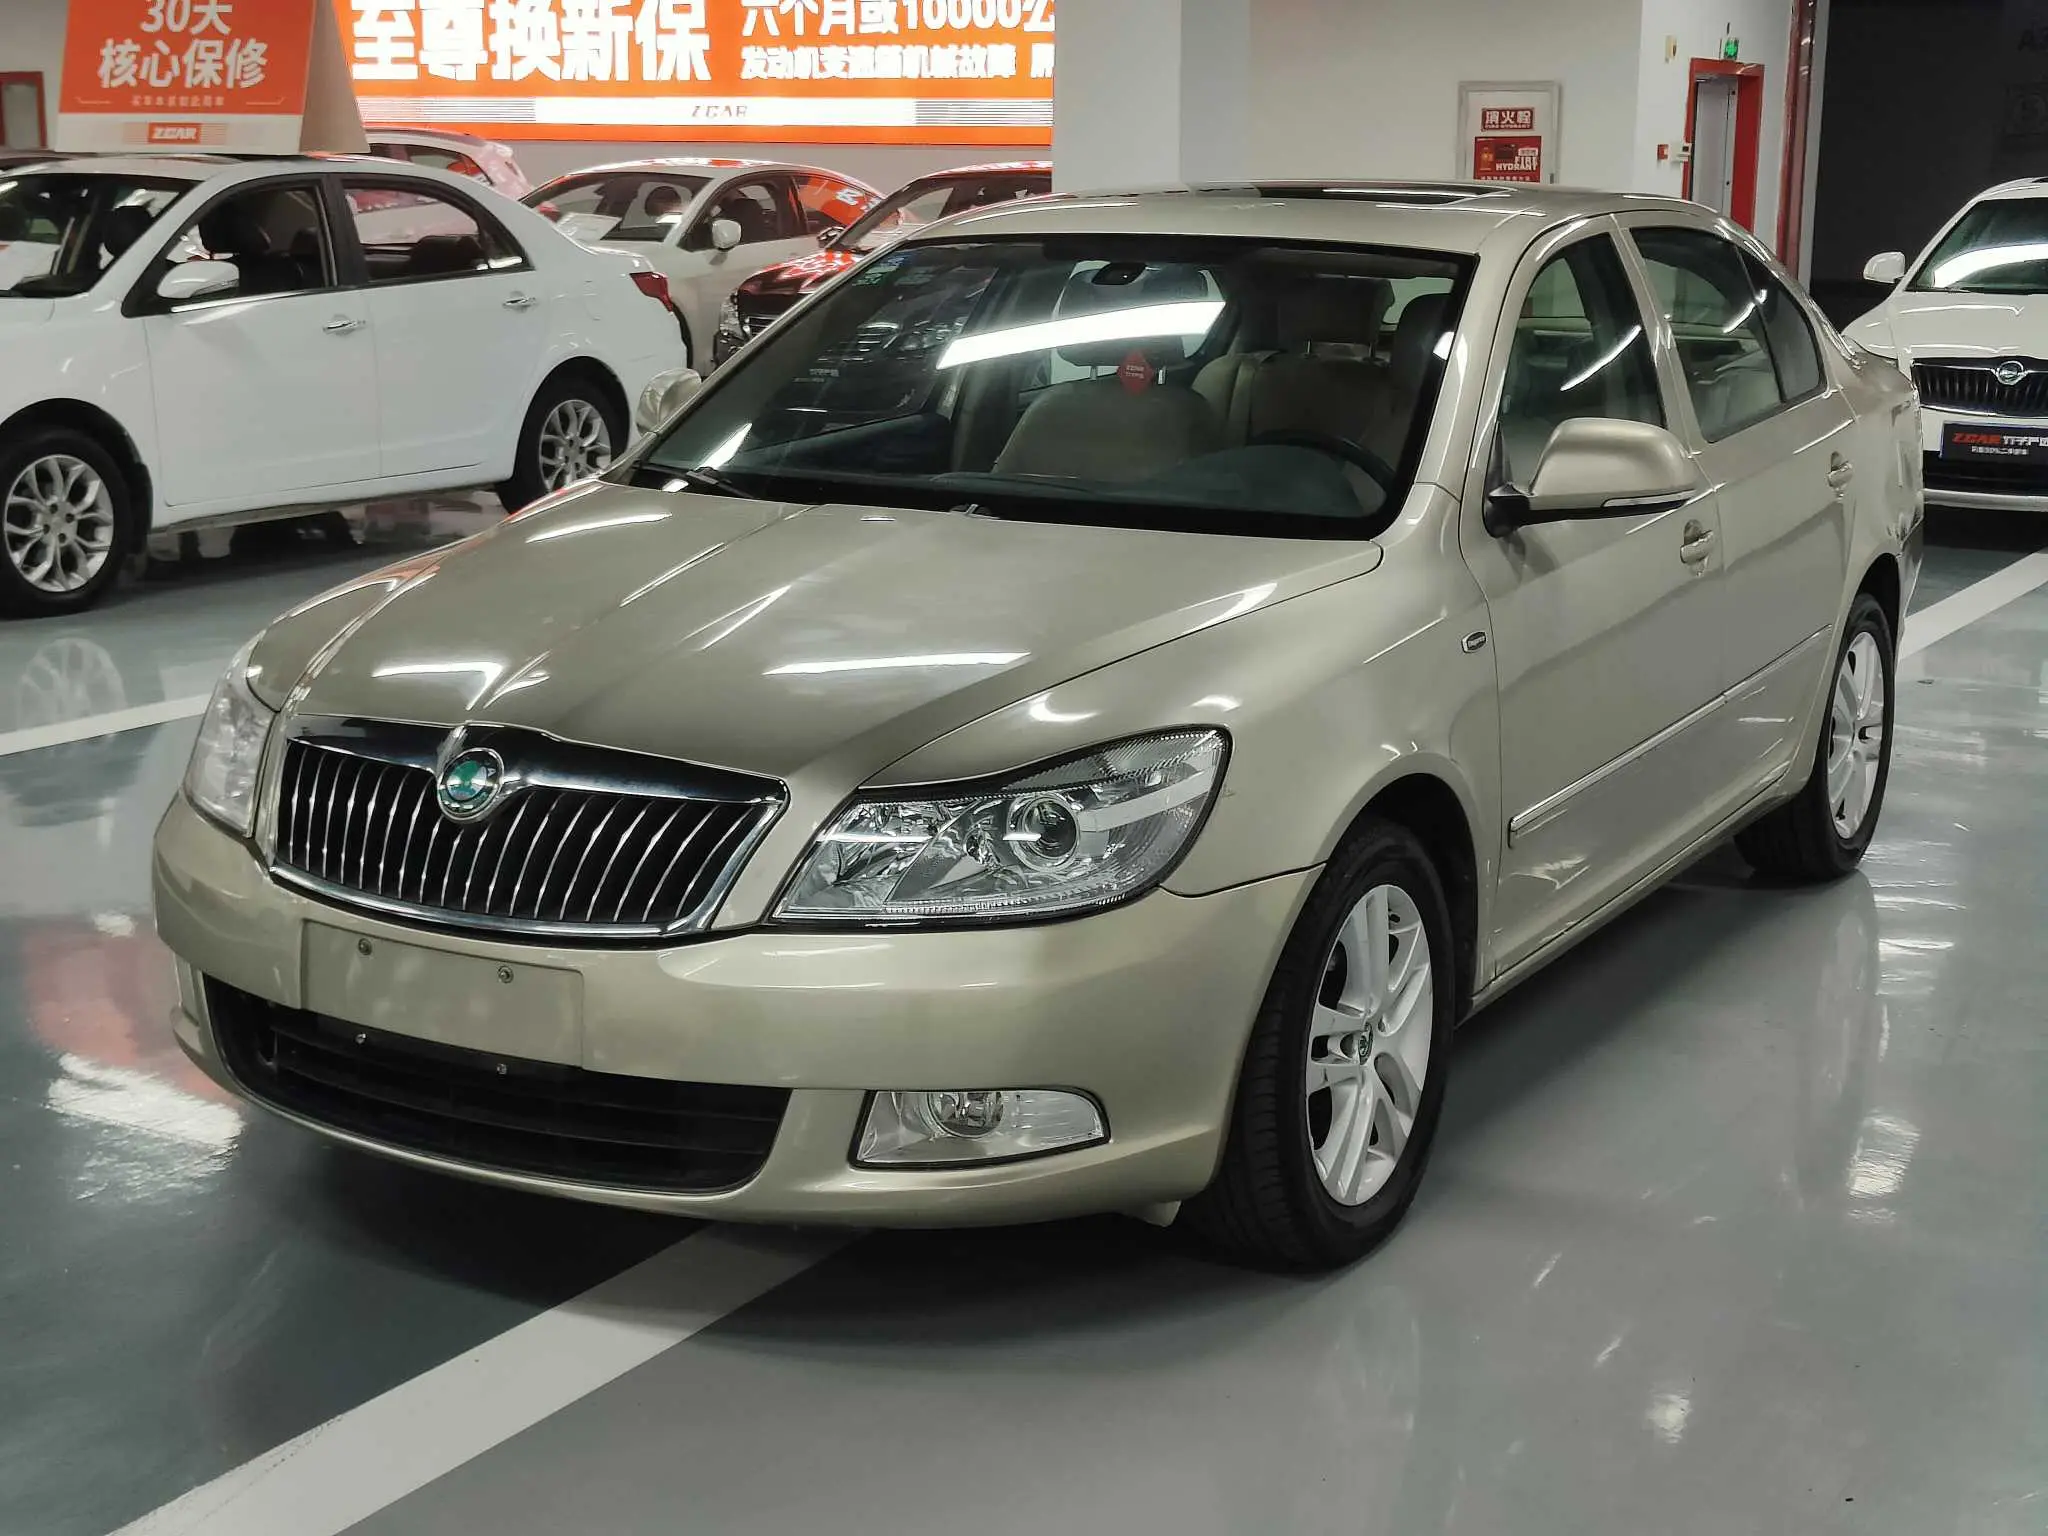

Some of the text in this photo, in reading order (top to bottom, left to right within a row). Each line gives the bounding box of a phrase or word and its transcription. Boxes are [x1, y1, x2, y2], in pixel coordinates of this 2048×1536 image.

[140, 0, 233, 35] 30天
[352, 0, 712, 81] 至尊换新保
[98, 38, 268, 88] 核心保修
